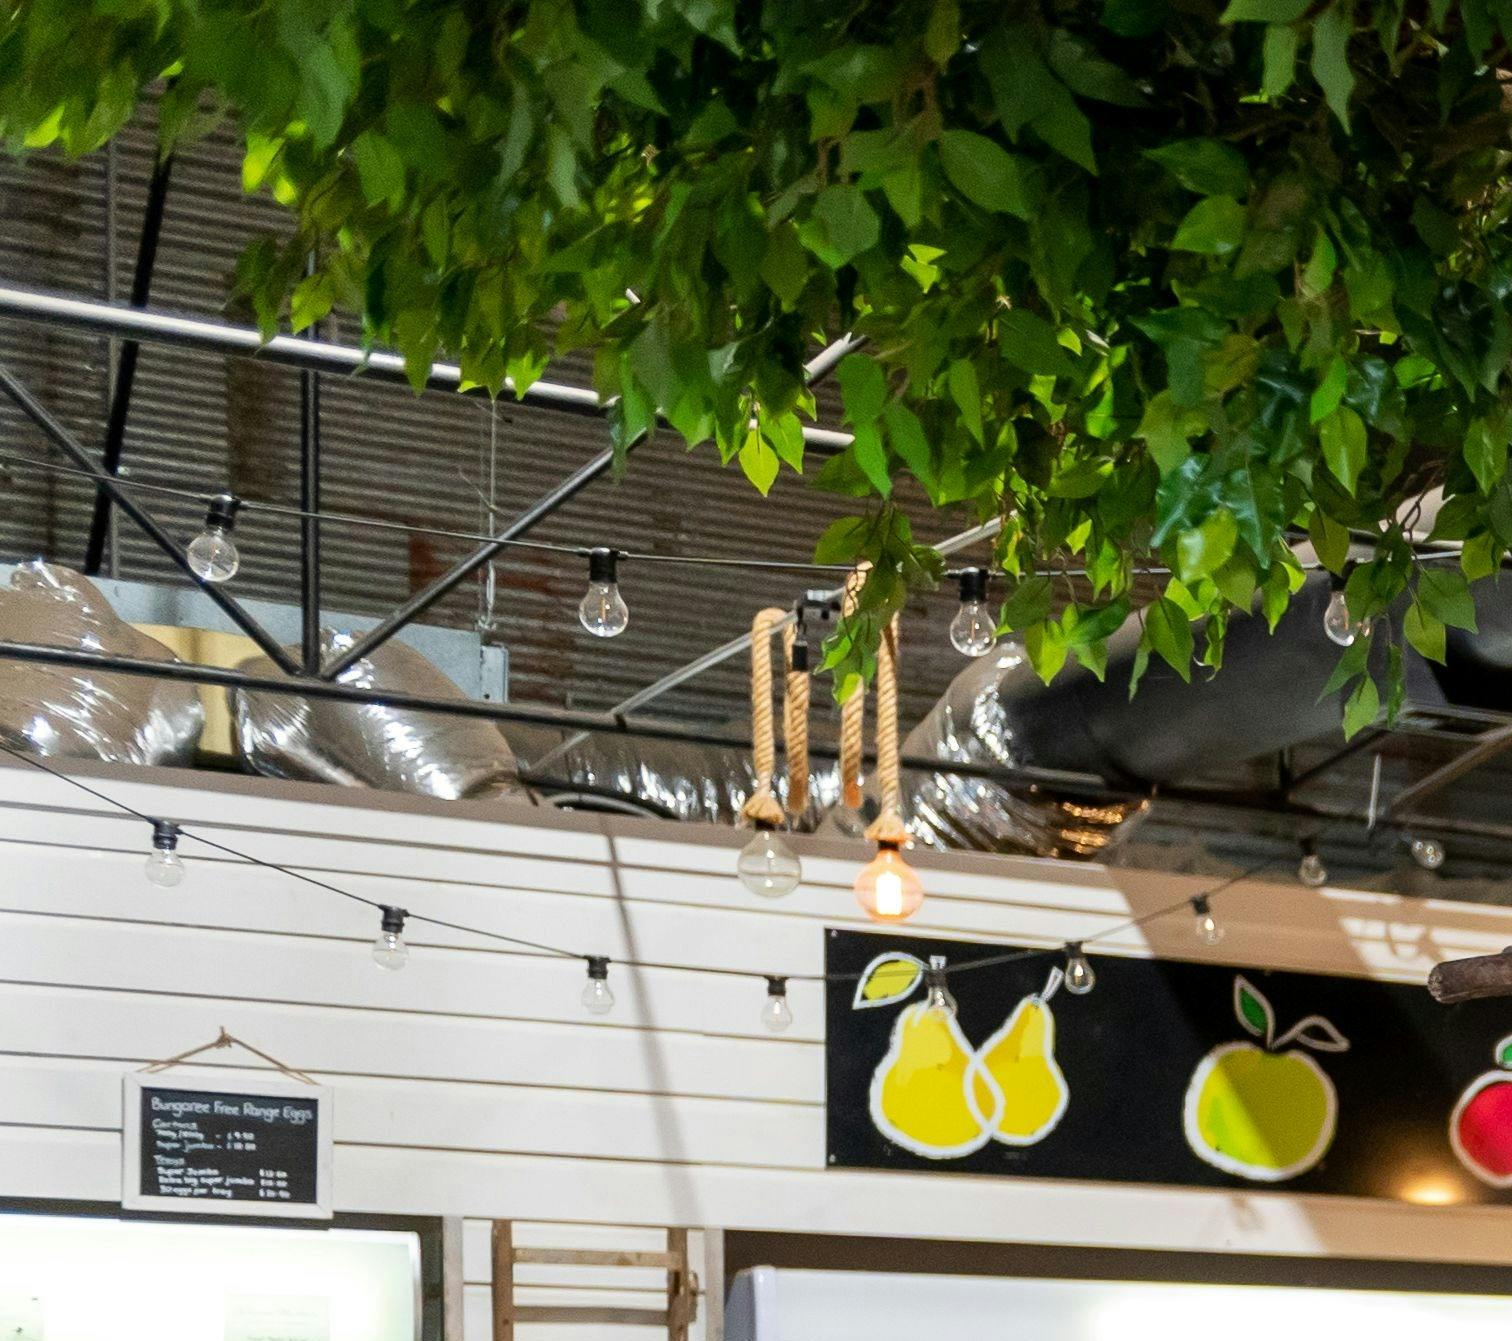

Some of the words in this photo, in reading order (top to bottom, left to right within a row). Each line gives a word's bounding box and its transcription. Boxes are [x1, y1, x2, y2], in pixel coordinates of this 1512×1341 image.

[214, 1100, 239, 1115] Free
[243, 1102, 280, 1123] Range
[282, 1106, 313, 1125] Eggs
